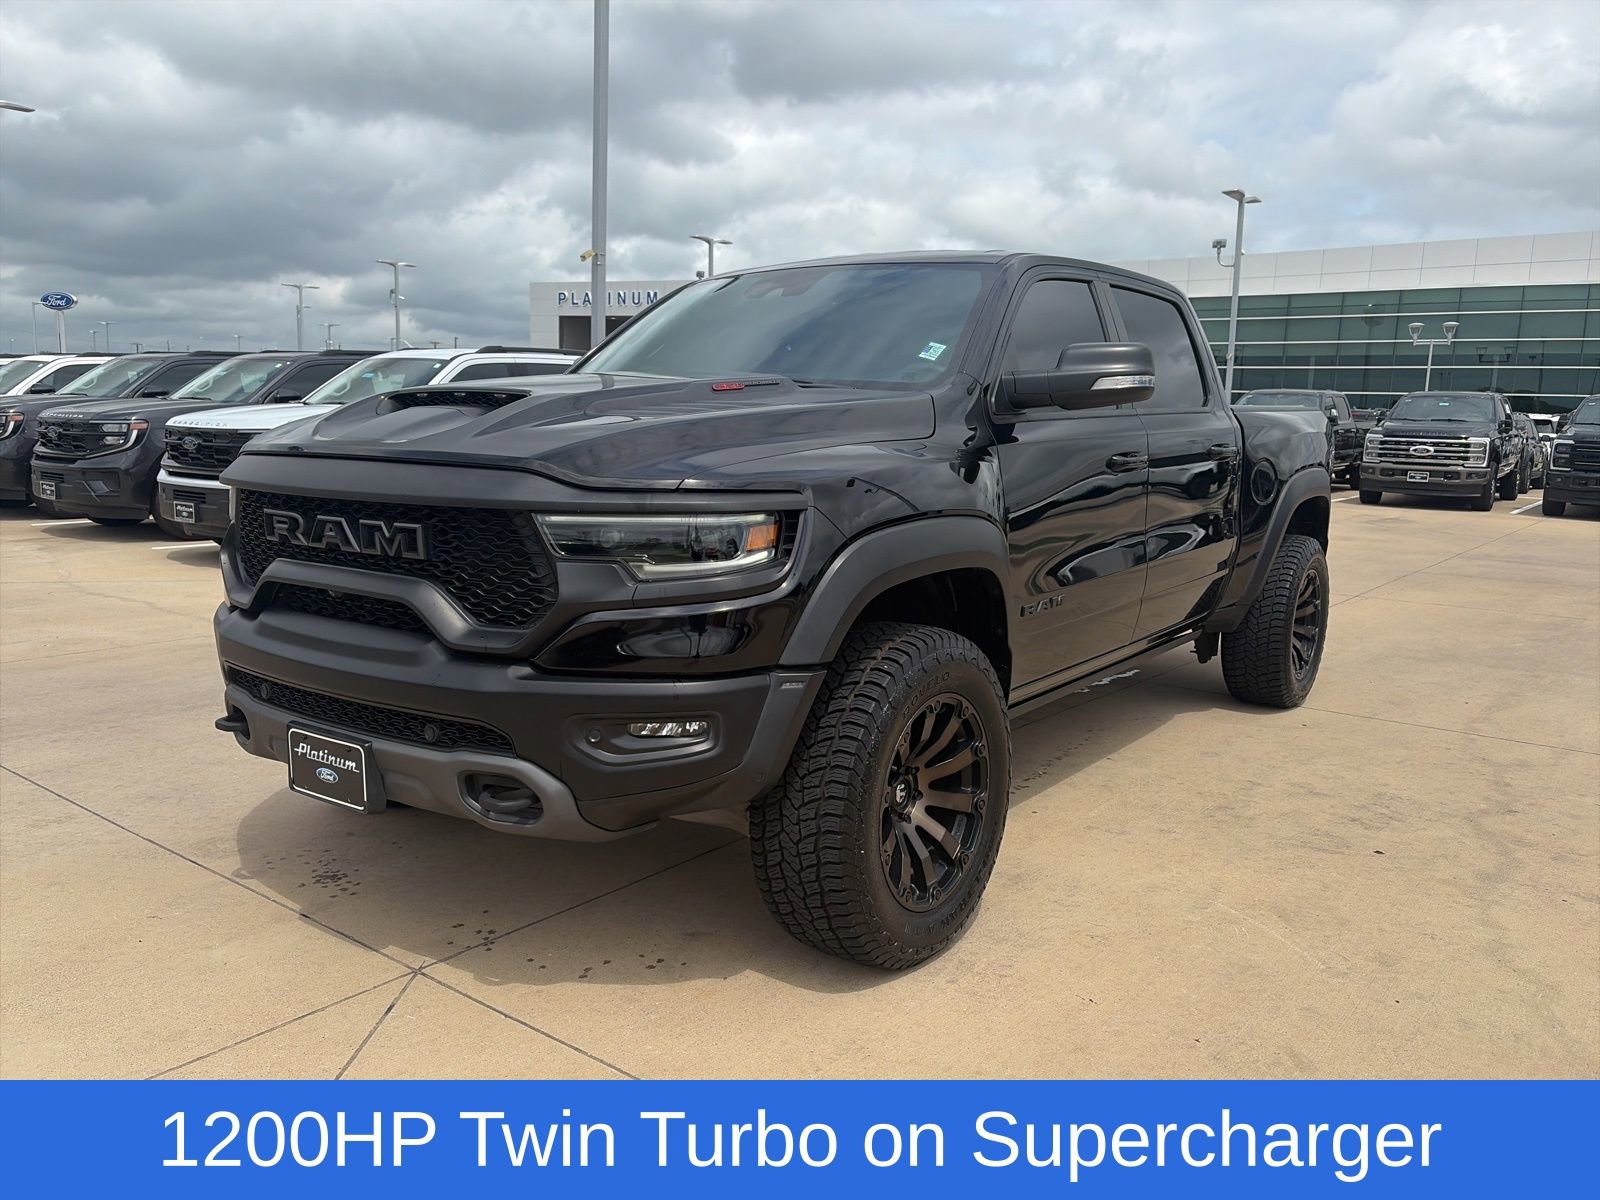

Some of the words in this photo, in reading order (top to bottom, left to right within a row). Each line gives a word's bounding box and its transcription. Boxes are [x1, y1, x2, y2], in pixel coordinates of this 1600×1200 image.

[46, 295, 67, 306] Ford
[558, 291, 658, 305] PLAINUM
[263, 508, 426, 560] RAM
[294, 742, 360, 773] Platinum
